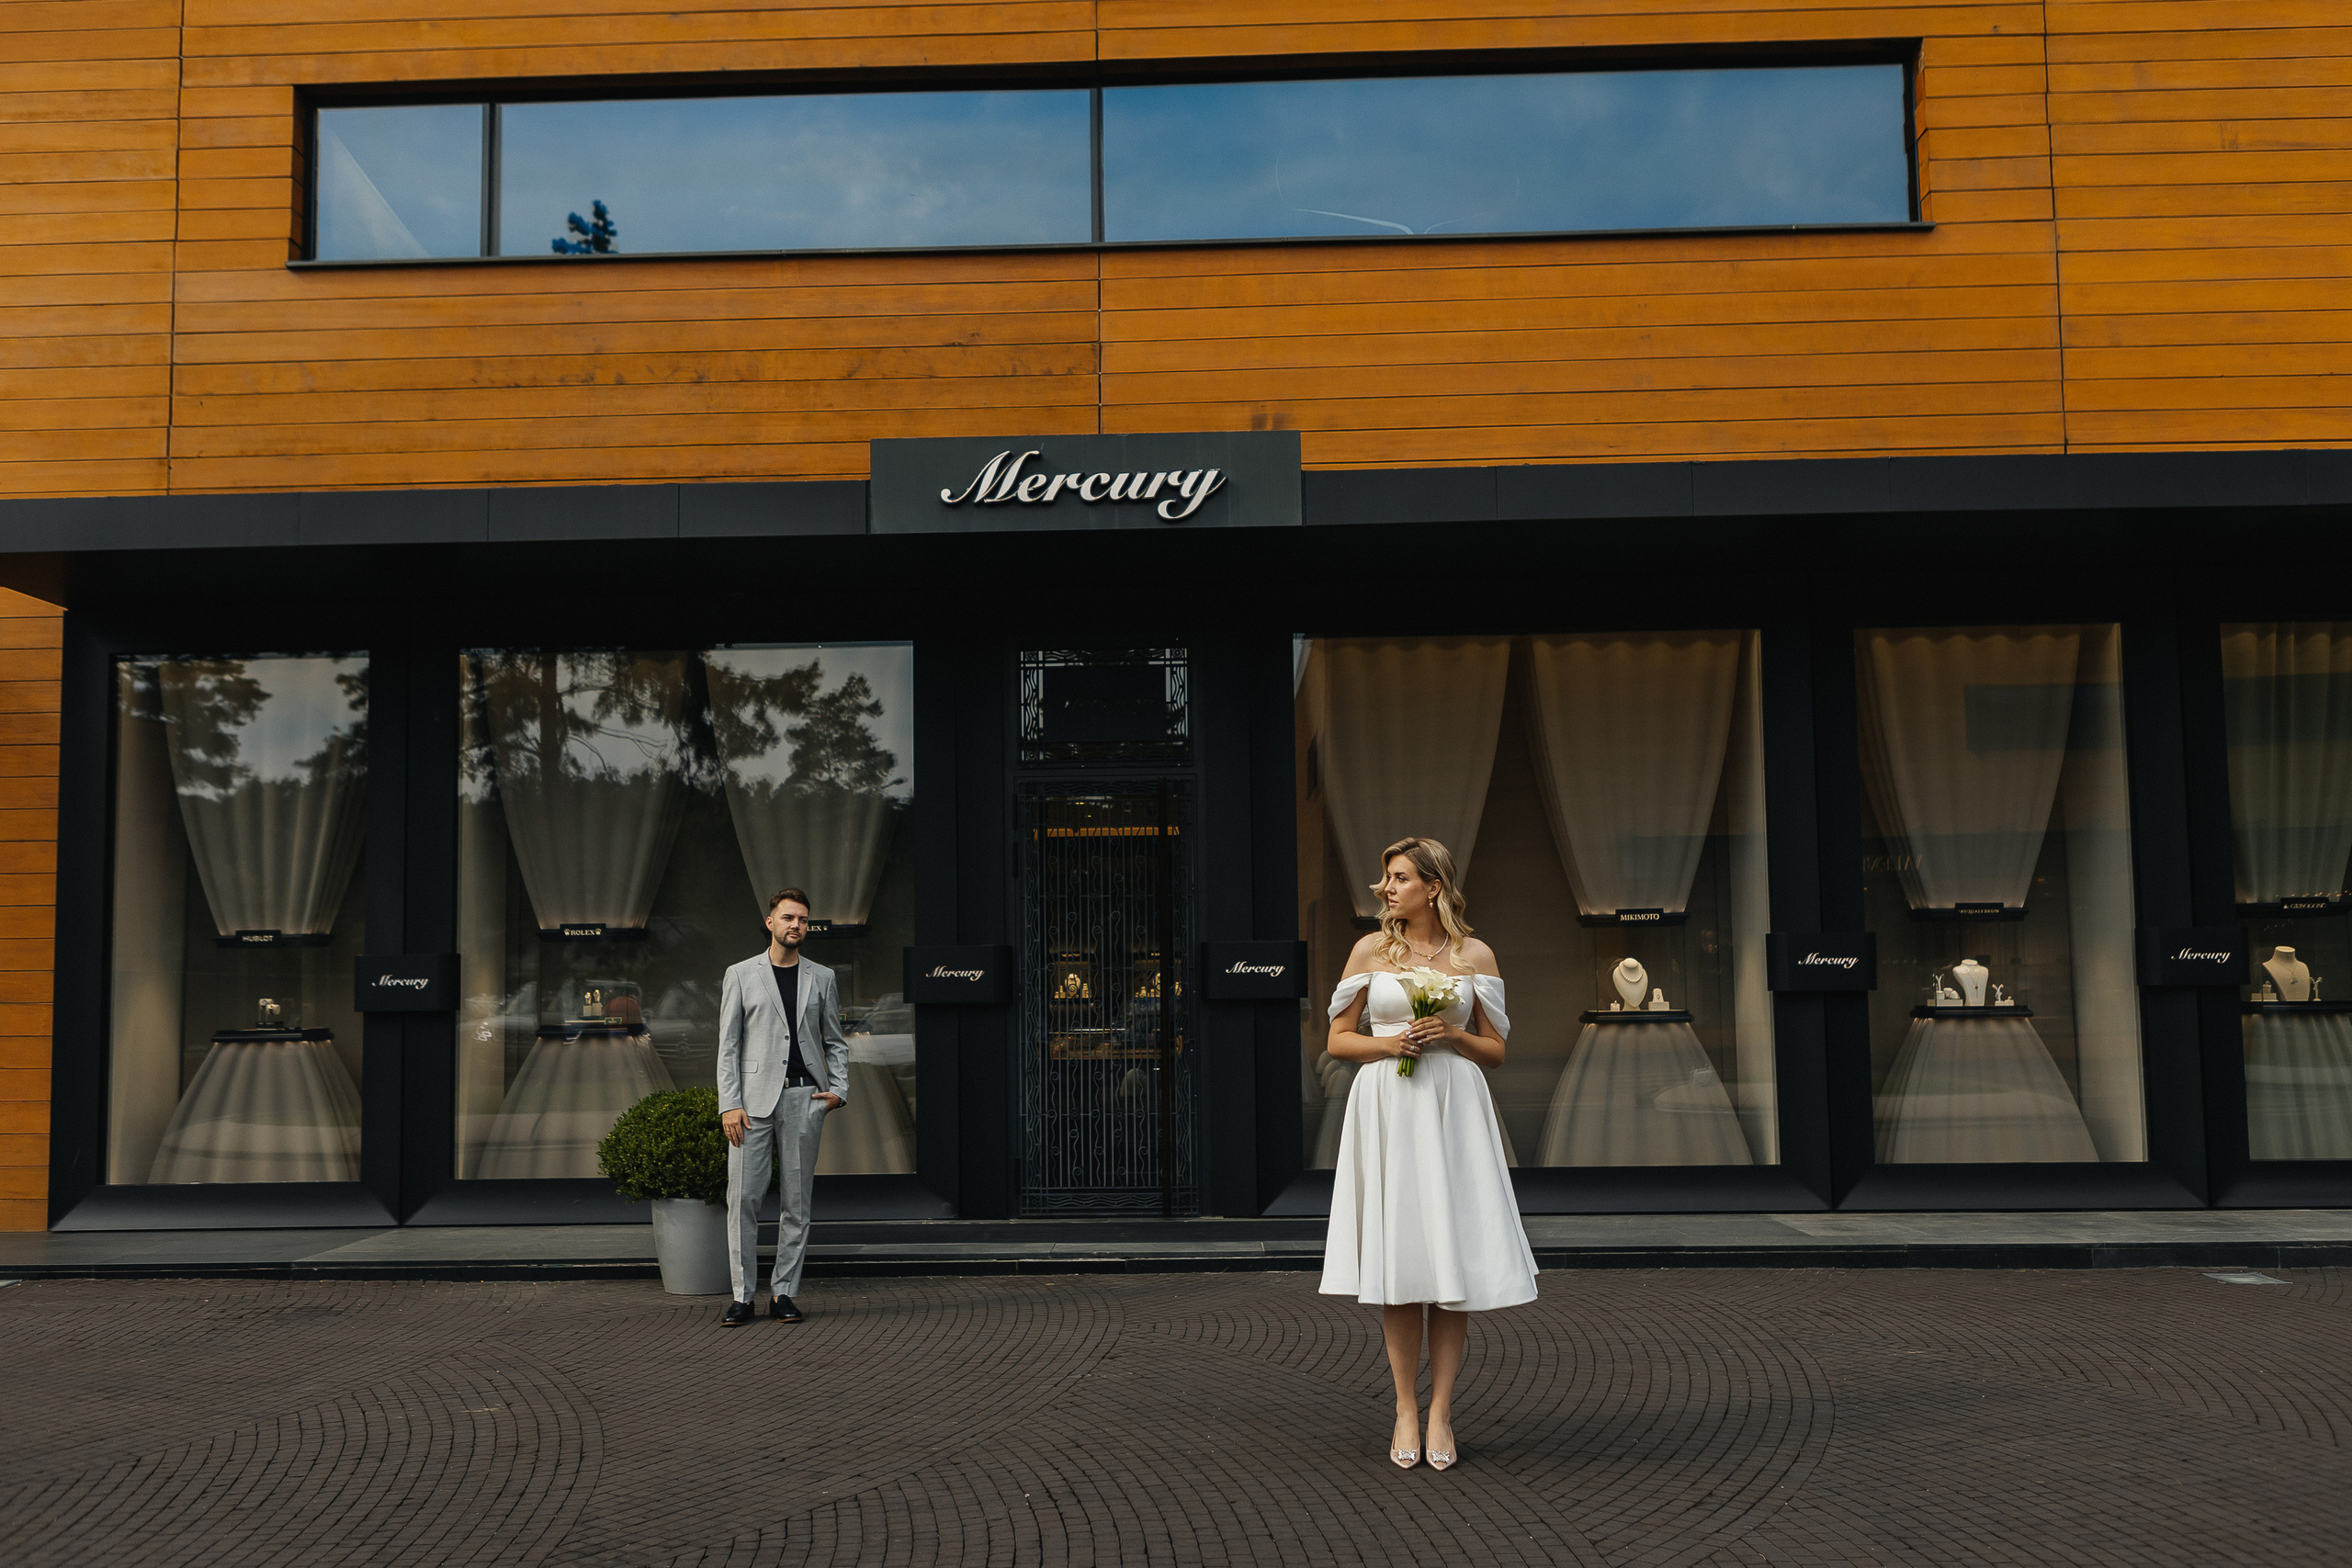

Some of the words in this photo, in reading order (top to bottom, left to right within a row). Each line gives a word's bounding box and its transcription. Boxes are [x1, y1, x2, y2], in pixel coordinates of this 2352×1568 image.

[940, 449, 1227, 520] Mercury
[1620, 912, 1660, 921] MIKIMOTO
[242, 934, 274, 942] HUBLOT
[1797, 952, 1860, 969] Mercury
[2170, 947, 2231, 964] Mercury
[925, 964, 985, 982] Mercury
[1225, 961, 1286, 977] Mercury
[371, 974, 429, 990] Mercury
